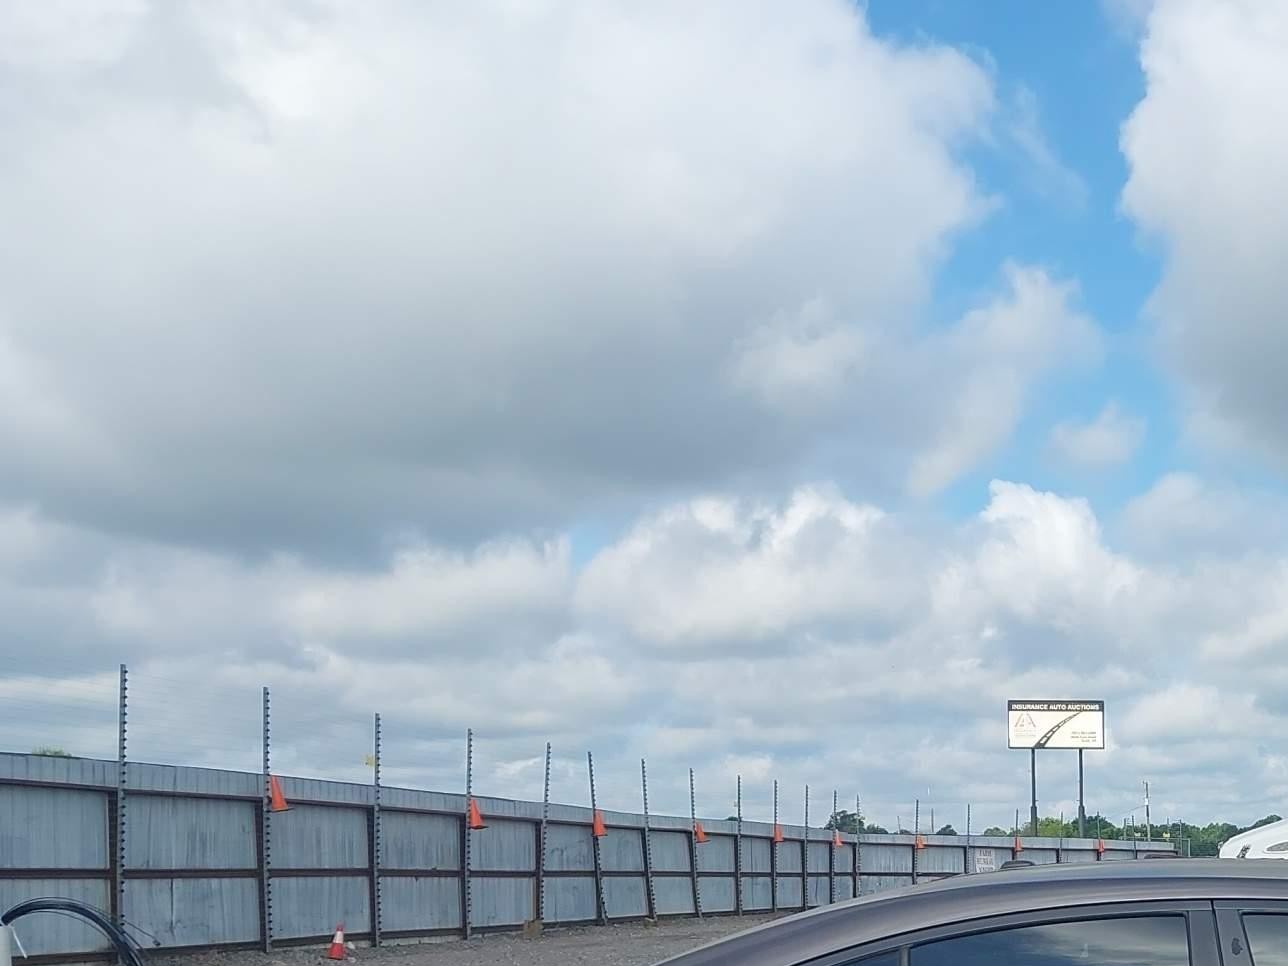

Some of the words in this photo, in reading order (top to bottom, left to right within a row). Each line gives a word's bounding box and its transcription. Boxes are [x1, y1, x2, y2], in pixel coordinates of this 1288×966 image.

[1011, 703, 1048, 711] INSURANCE
[1049, 703, 1067, 711] AUTO
[1067, 703, 1100, 711] AUCTIONS
